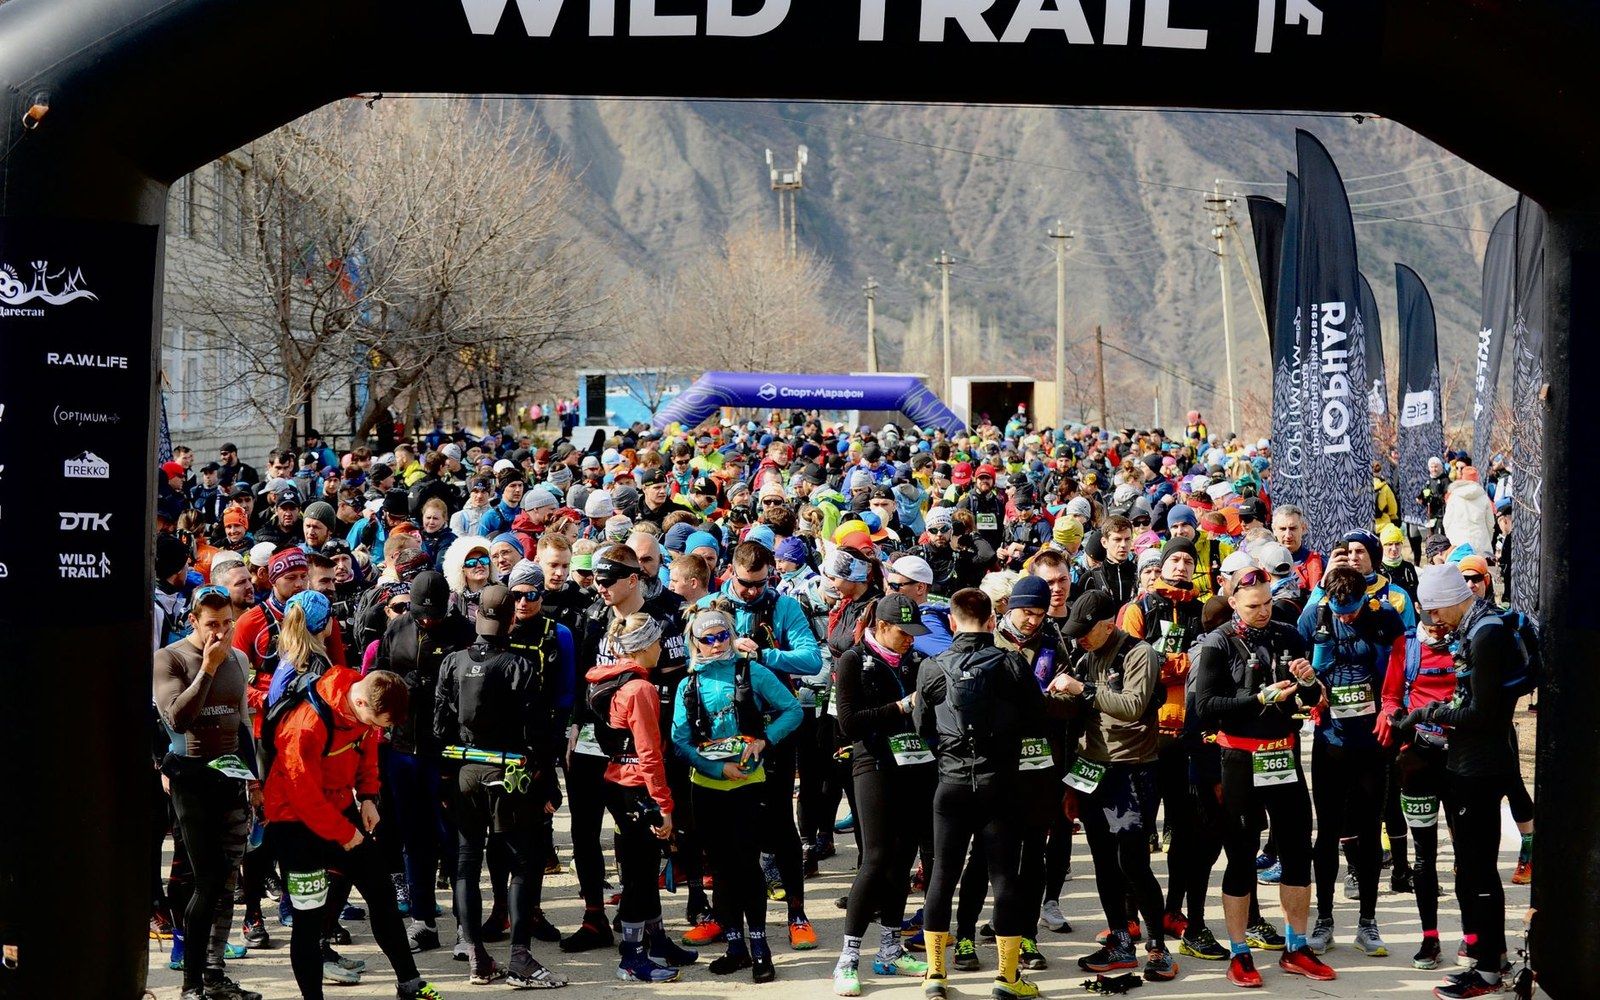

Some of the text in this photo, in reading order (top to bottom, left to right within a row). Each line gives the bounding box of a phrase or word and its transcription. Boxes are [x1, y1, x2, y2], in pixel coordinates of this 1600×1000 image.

[67, 465, 107, 475] TREKKO
[59, 512, 112, 531] DTK
[59, 553, 96, 565] WILD
[59, 566, 100, 578] TRAIL
[1337, 691, 1366, 703] 3668
[899, 740, 921, 750] 3435
[1257, 738, 1288, 751] LEKI
[1262, 757, 1288, 770] 3663
[1406, 803, 1432, 813] 3219
[297, 877, 326, 893] 3298
